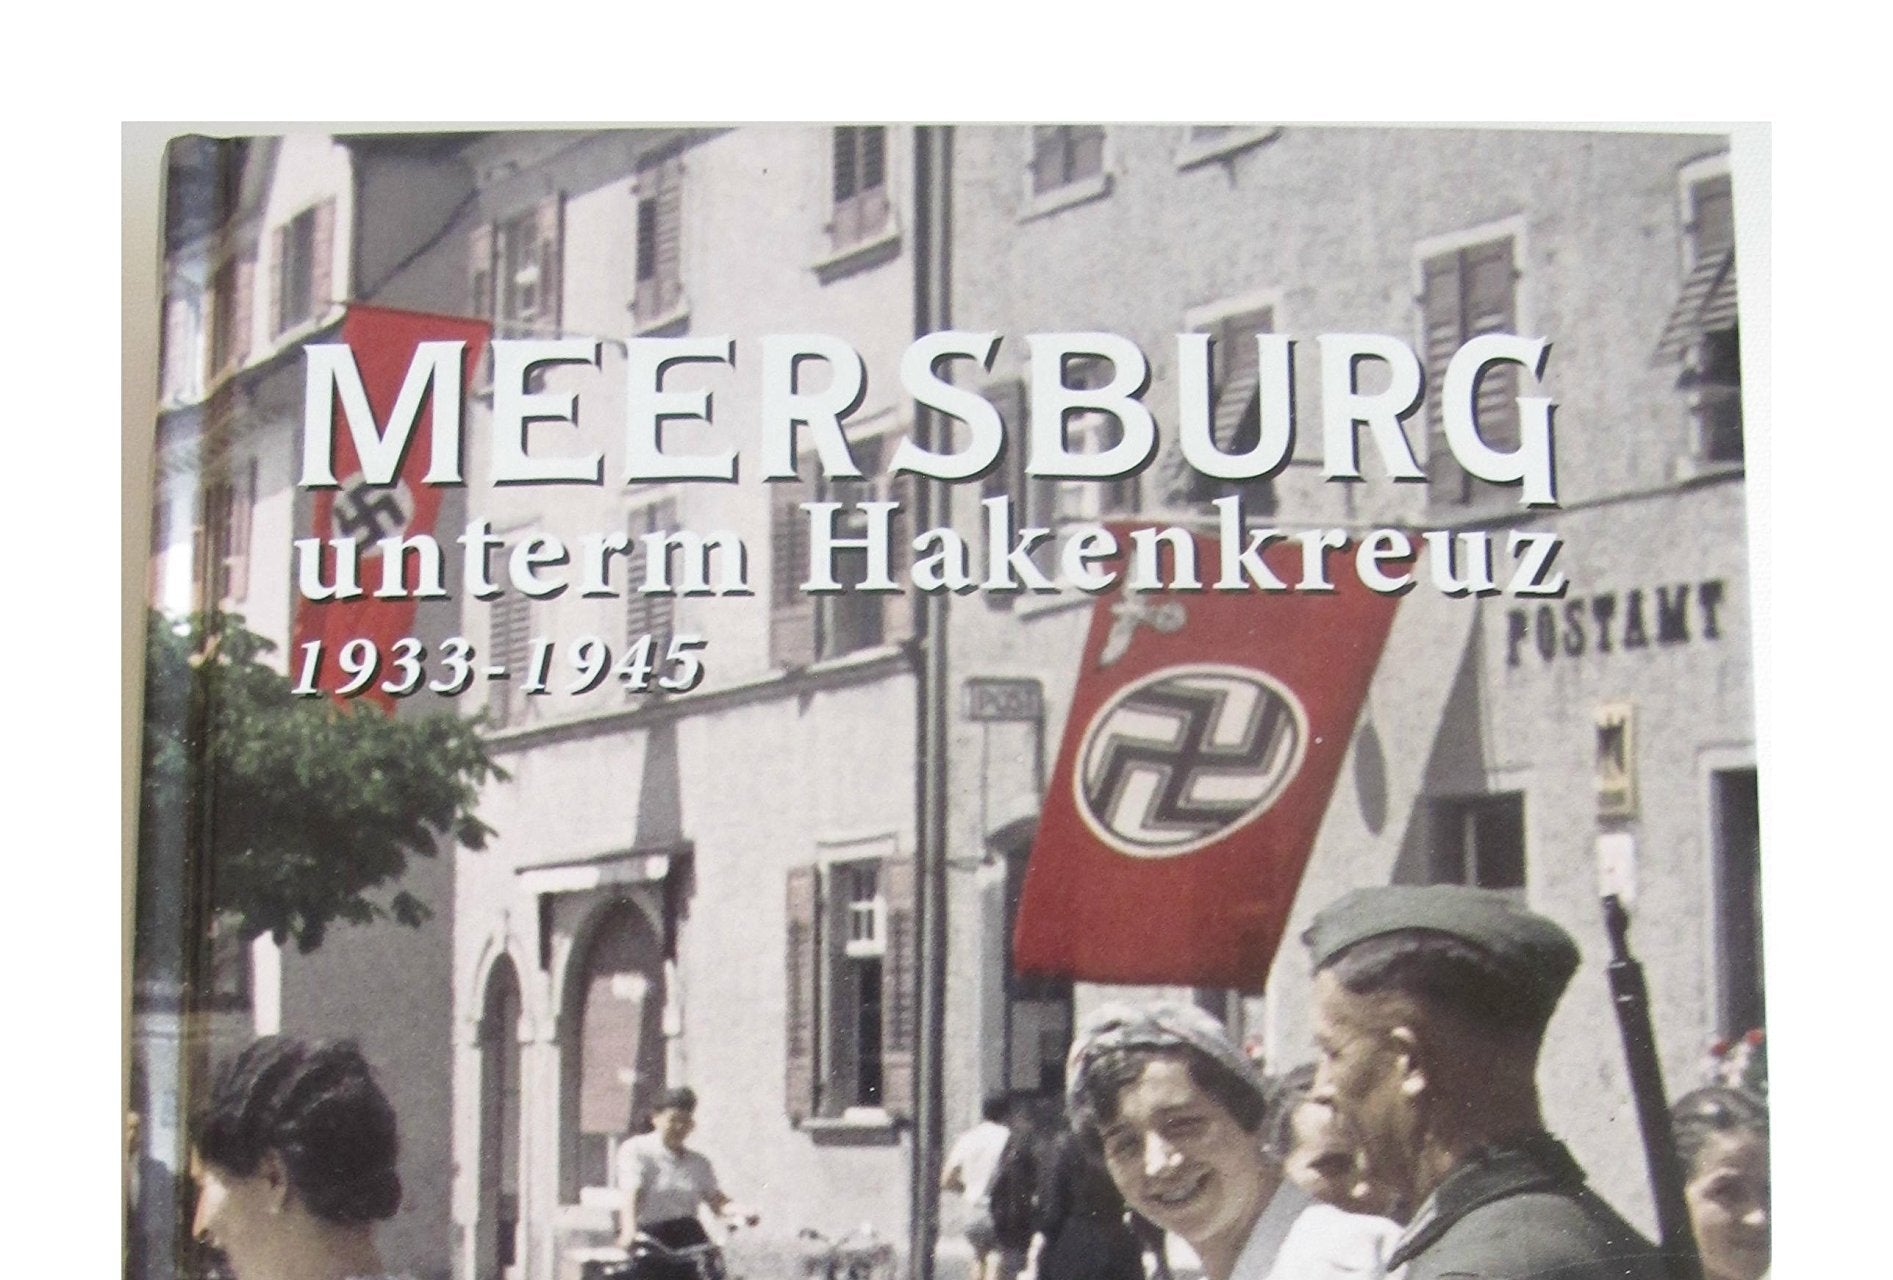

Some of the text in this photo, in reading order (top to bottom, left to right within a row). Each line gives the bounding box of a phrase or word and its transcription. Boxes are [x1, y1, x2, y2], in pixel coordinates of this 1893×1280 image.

[296, 330, 1559, 509] MEERSBURG
[294, 496, 1567, 602] unterm Hakenkreuz
[290, 634, 708, 699] 1933-1945
[1506, 579, 1725, 668] POSTAMT
